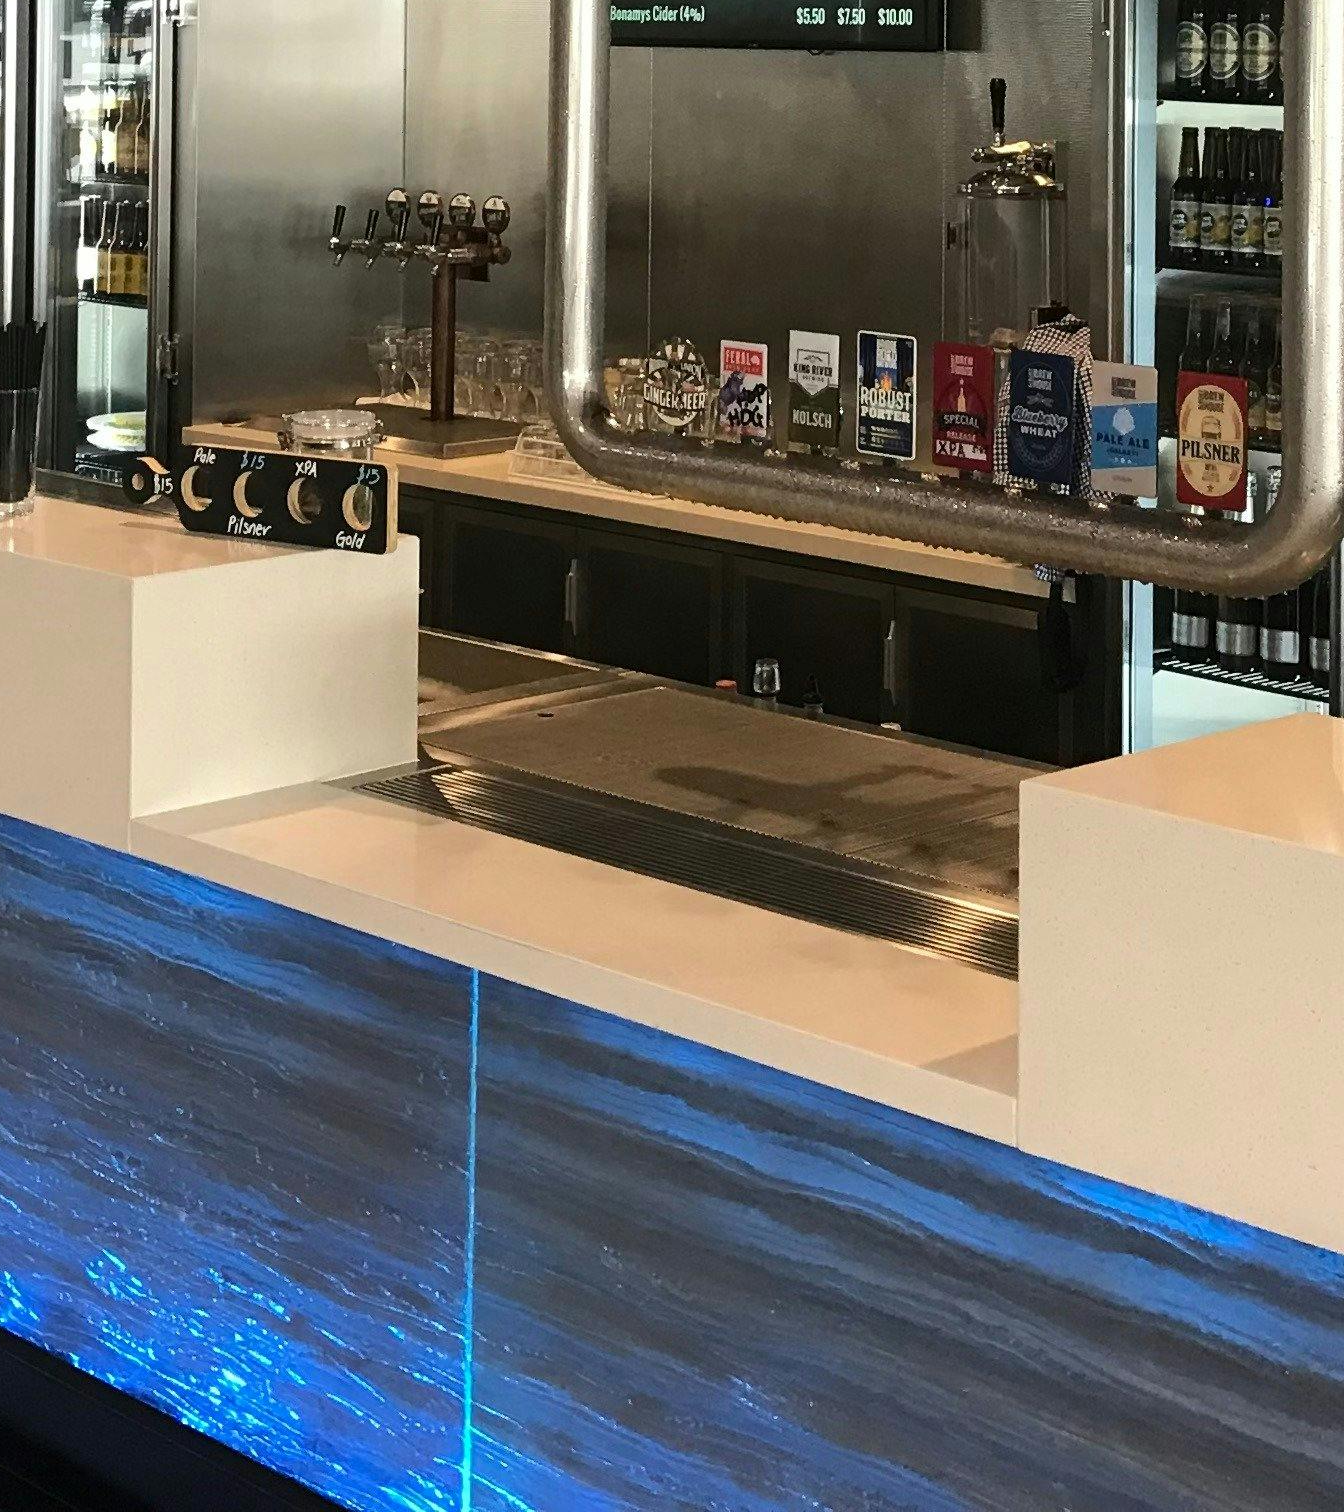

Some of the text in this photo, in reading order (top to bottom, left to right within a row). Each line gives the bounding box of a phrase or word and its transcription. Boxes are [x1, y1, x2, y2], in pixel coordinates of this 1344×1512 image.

[610, 5, 913, 26] Bonamys Cider (4%) $5.50 $7.50 $10.00
[860, 385, 912, 412] ROBUST
[860, 404, 911, 424] PORTER
[943, 413, 980, 429] SPECIAL
[1020, 425, 1058, 438] WHEAT
[1096, 431, 1150, 450] PALE ALE
[194, 447, 216, 465] Pale
[240, 450, 266, 470] $15
[1181, 439, 1241, 464] PILSNER
[294, 460, 318, 478] XPA
[356, 463, 381, 485] $15
[153, 473, 174, 495] $15
[227, 514, 273, 537] Pilsner
[335, 530, 365, 550] Gold
